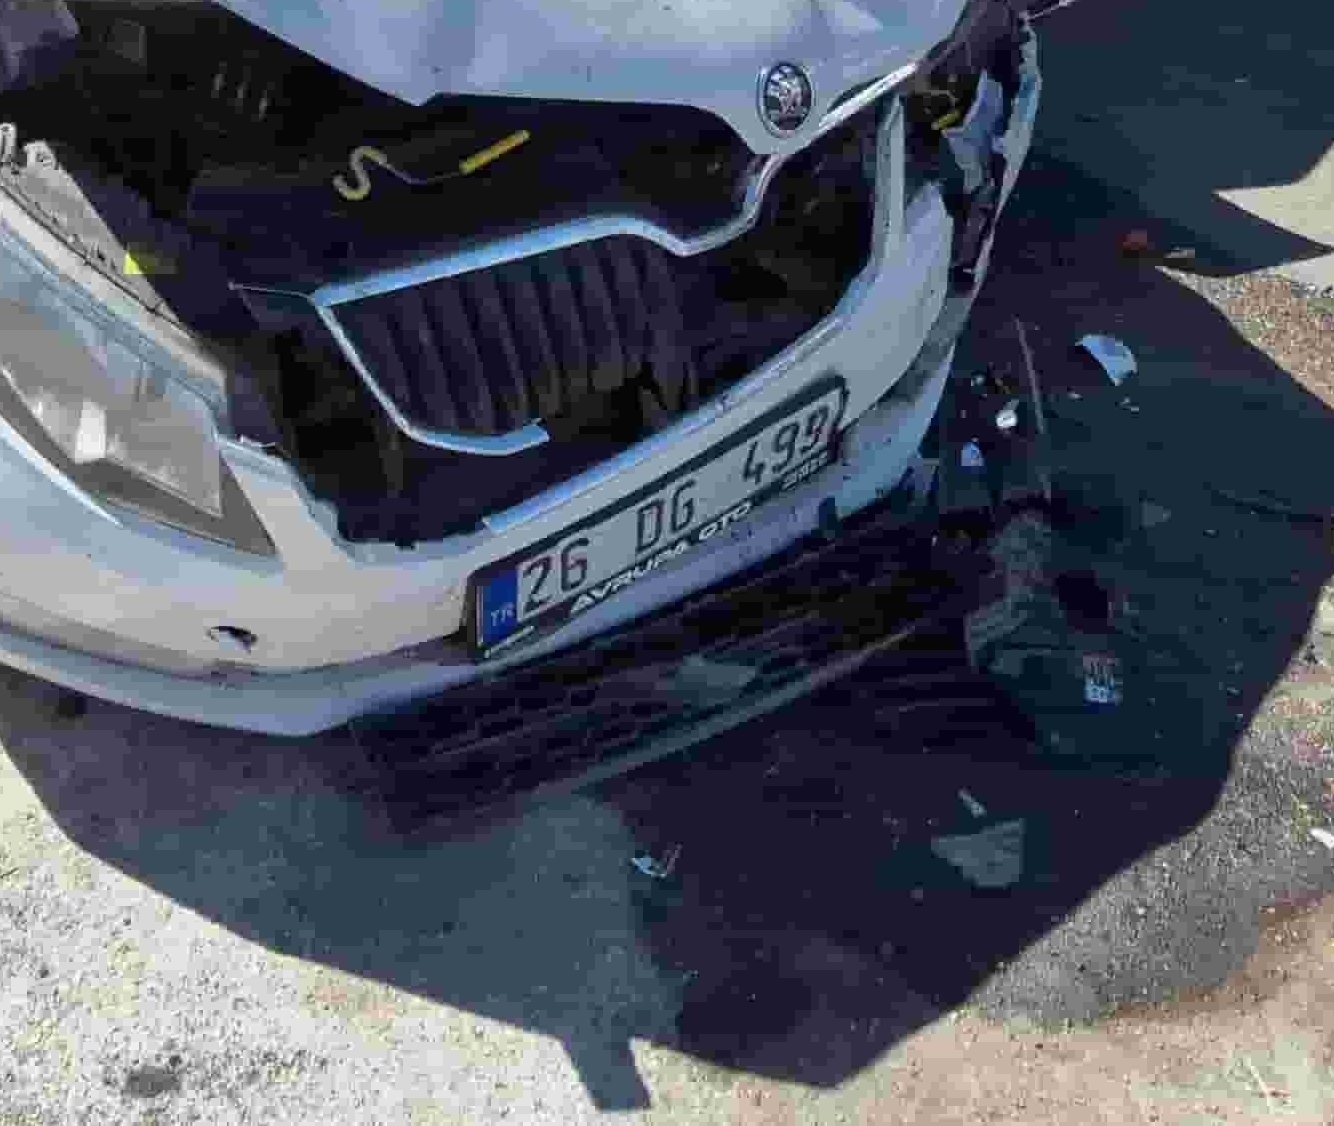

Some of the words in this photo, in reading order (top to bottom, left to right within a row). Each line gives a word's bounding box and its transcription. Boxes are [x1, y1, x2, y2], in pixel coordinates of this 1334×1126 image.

[490, 602, 516, 627] TR
[522, 537, 590, 613] 26
[636, 478, 696, 552] DG
[742, 403, 831, 485] 499
[571, 539, 688, 614] AVRUPA
[698, 501, 752, 541] OTO
